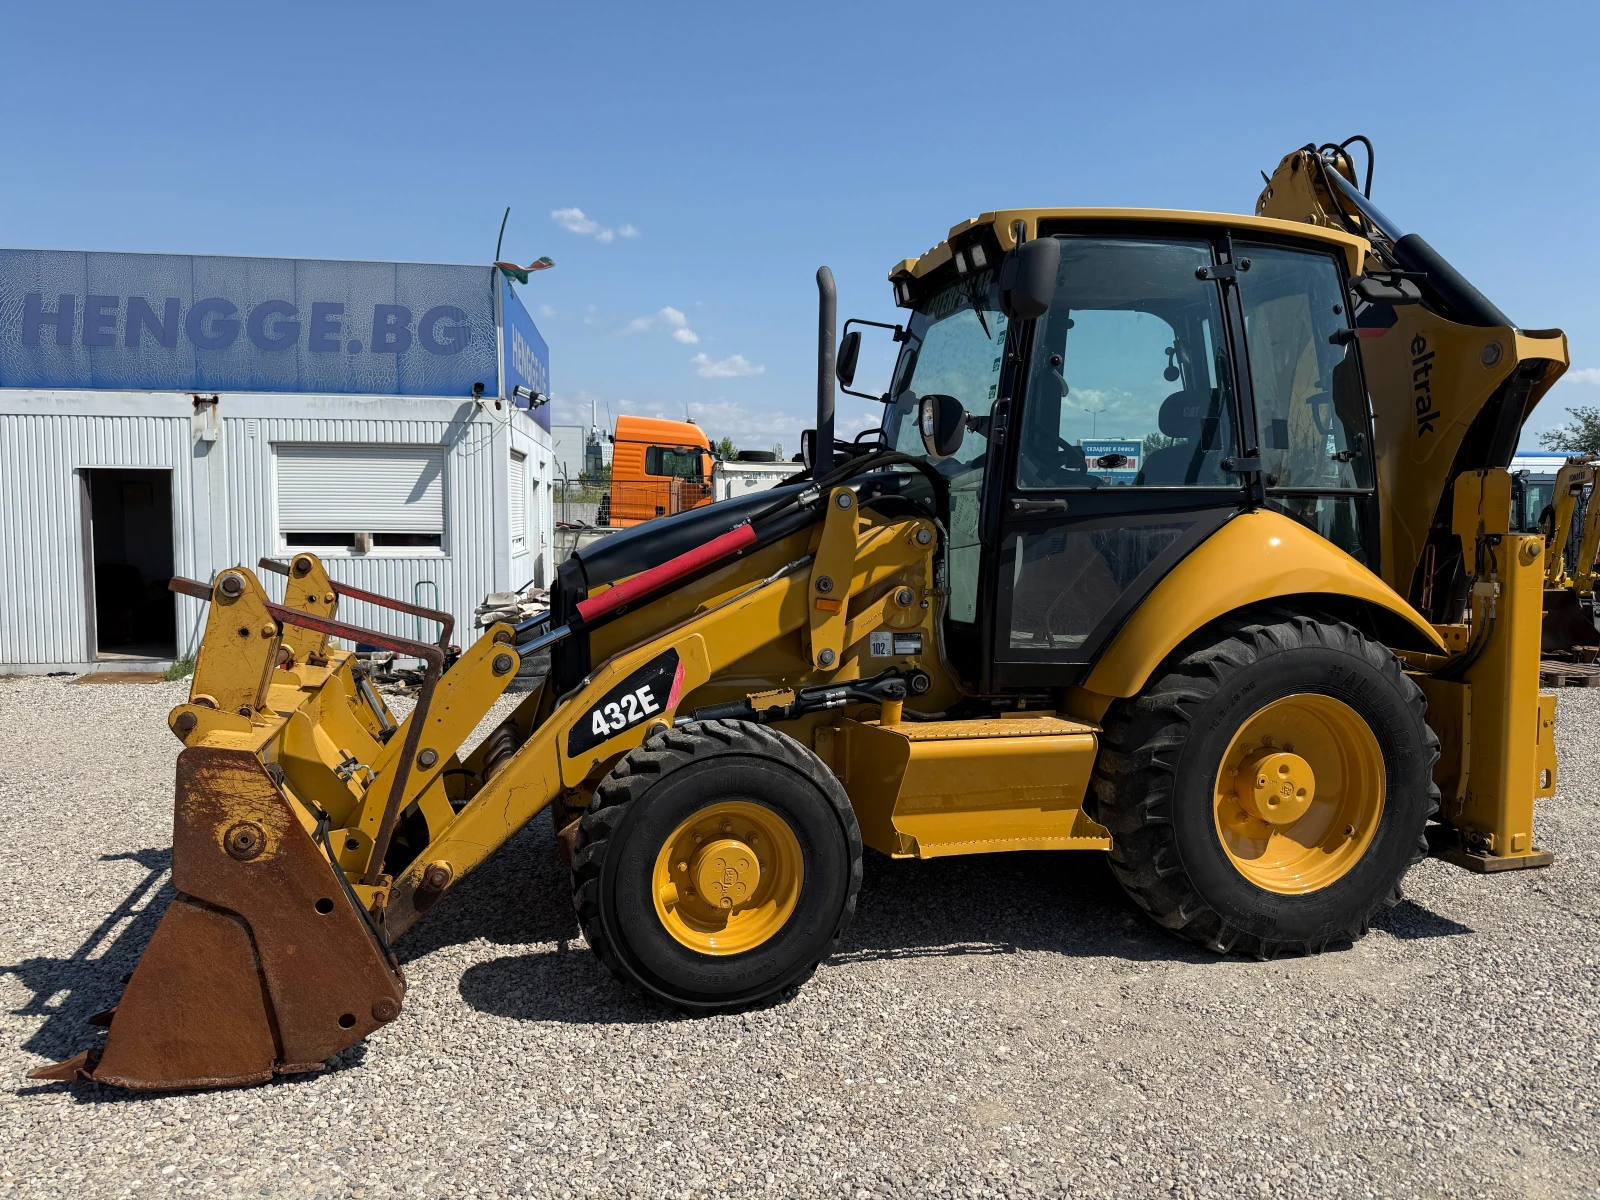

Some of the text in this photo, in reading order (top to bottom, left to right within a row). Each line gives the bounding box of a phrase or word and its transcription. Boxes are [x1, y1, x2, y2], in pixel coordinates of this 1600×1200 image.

[21, 292, 472, 357] HENGGE.BG
[1410, 332, 1441, 438] eltrak
[1183, 406, 1200, 418] CAT
[872, 642, 886, 655] 102
[592, 684, 660, 736] 432E
